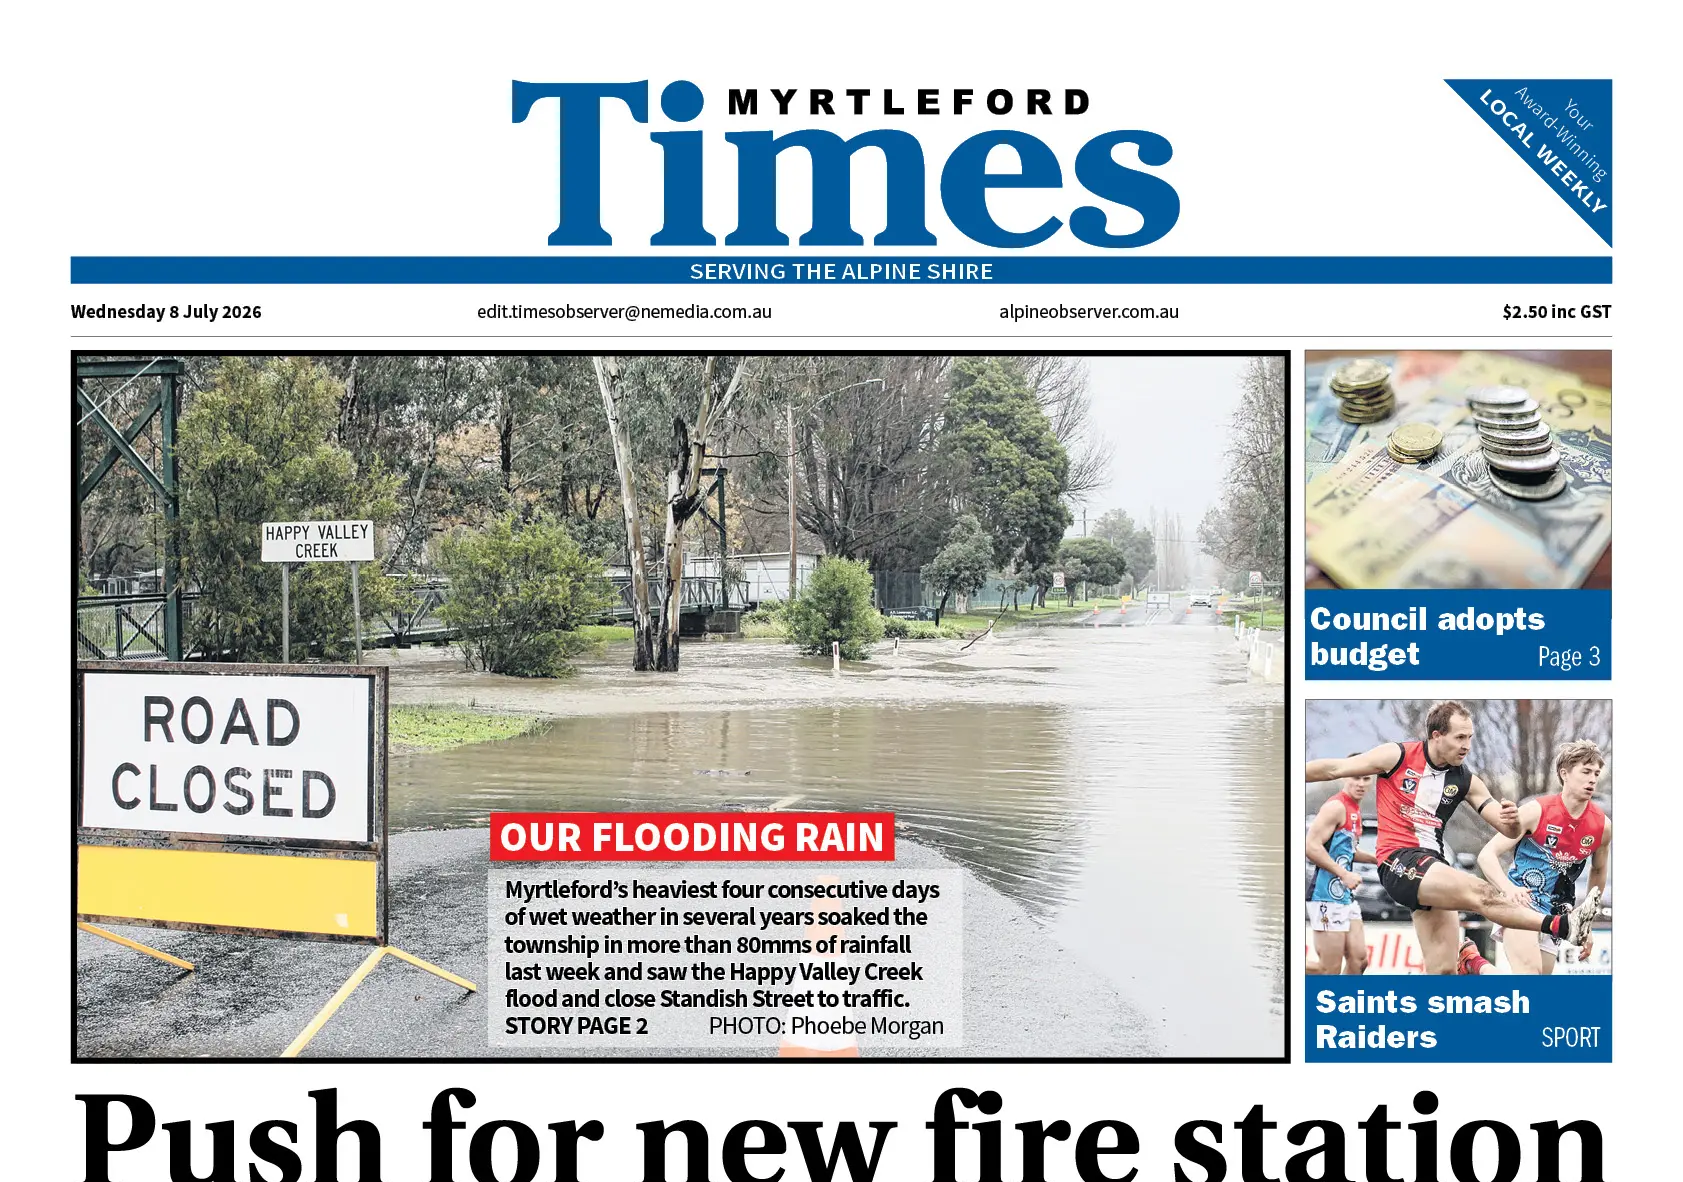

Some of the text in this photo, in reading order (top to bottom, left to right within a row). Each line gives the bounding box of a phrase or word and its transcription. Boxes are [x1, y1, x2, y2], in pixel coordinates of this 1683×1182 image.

[729, 89, 1088, 115] MYRTLEFORD
[1564, 98, 1594, 131] Your
[1514, 86, 1608, 183] Award-Winning
[1479, 88, 1608, 214] LOCAL WEEKLY
[512, 80, 1180, 248] Times
[691, 264, 992, 279] SERVING THE ALPINE SHIRE
[71, 304, 261, 322] Wednesday 8 July 2026
[478, 304, 771, 321] edit.timesobserver@nemedia.com.au
[1000, 304, 1178, 322] alpineobserver.com.au
[1503, 304, 1611, 320] $2.50 inc GST
[267, 525, 368, 540] HAPPY VALLEY
[296, 543, 337, 558] CREEK
[1311, 607, 1545, 635] Council adopts
[1312, 642, 1419, 671] budget
[1540, 646, 1600, 670] Page 3
[145, 696, 299, 746] ROAD
[112, 763, 335, 818] CLOSED
[501, 823, 882, 851] OUR FLOODING RAIN
[507, 880, 939, 902] Myrtleford’s heaviest four consecutive days
[1316, 990, 1529, 1013] Saints smash
[506, 1017, 648, 1034] STORY PAGE 2
[711, 1016, 943, 1040] PHOTO: Phoebe Morgan
[1317, 1025, 1437, 1048] Raiders
[1543, 1027, 1600, 1047] SPORT
